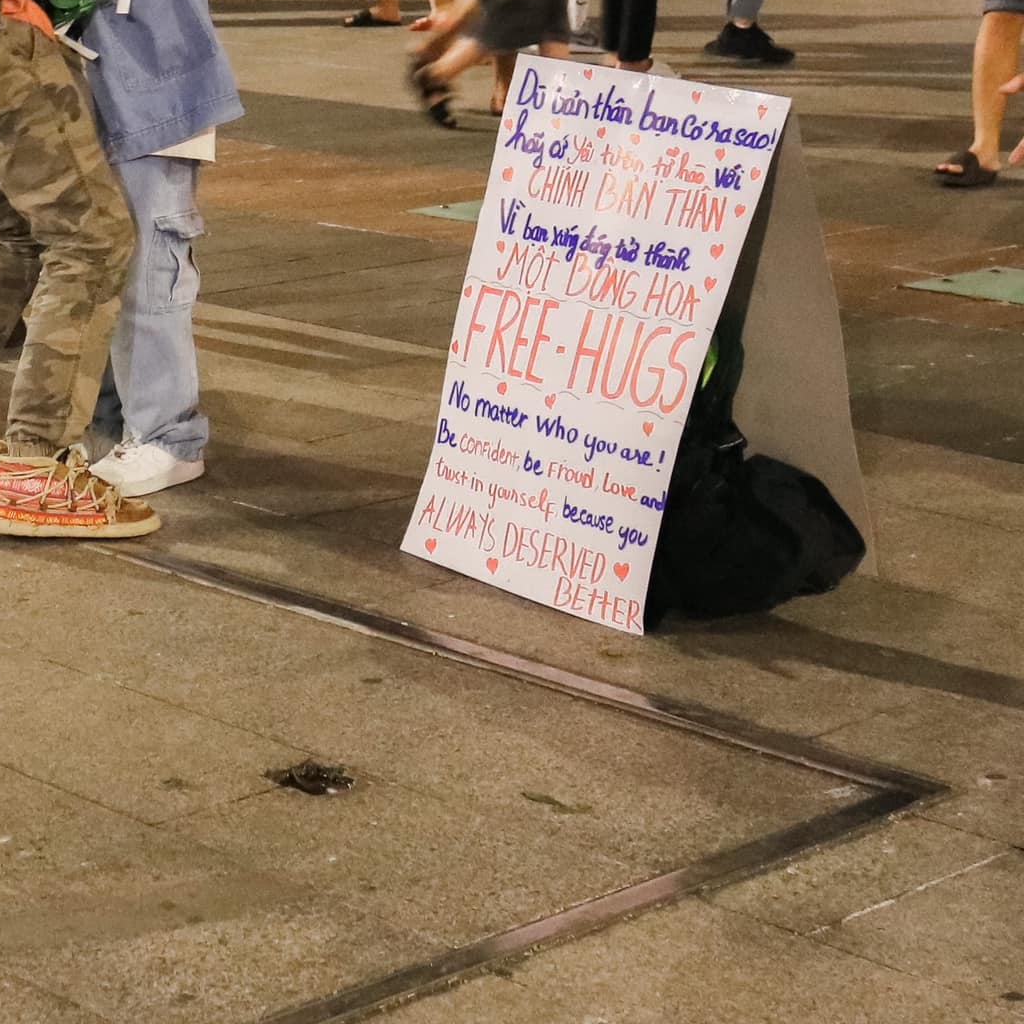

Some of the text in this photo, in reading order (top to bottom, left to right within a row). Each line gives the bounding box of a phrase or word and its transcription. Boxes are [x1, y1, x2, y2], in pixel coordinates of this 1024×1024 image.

[504, 108, 544, 168] hãy
[592, 85, 632, 125] thân
[639, 89, 678, 136] bạn
[500, 198, 526, 235] Vì
[522, 213, 548, 246] bạn
[527, 166, 727, 233] CHÍNH BẢN THÂN
[565, 252, 640, 310] BÔNG
[643, 272, 701, 322] HOA
[448, 380, 470, 412] No
[474, 398, 528, 428] matter
[584, 434, 617, 462] you
[437, 418, 457, 447] Be
[523, 450, 543, 475] be
[640, 490, 666, 511] and
[436, 457, 468, 486] trust
[470, 472, 483, 492] in
[562, 496, 614, 533] because
[618, 525, 648, 550] you
[418, 494, 607, 584] ALWAYS DESERVED
